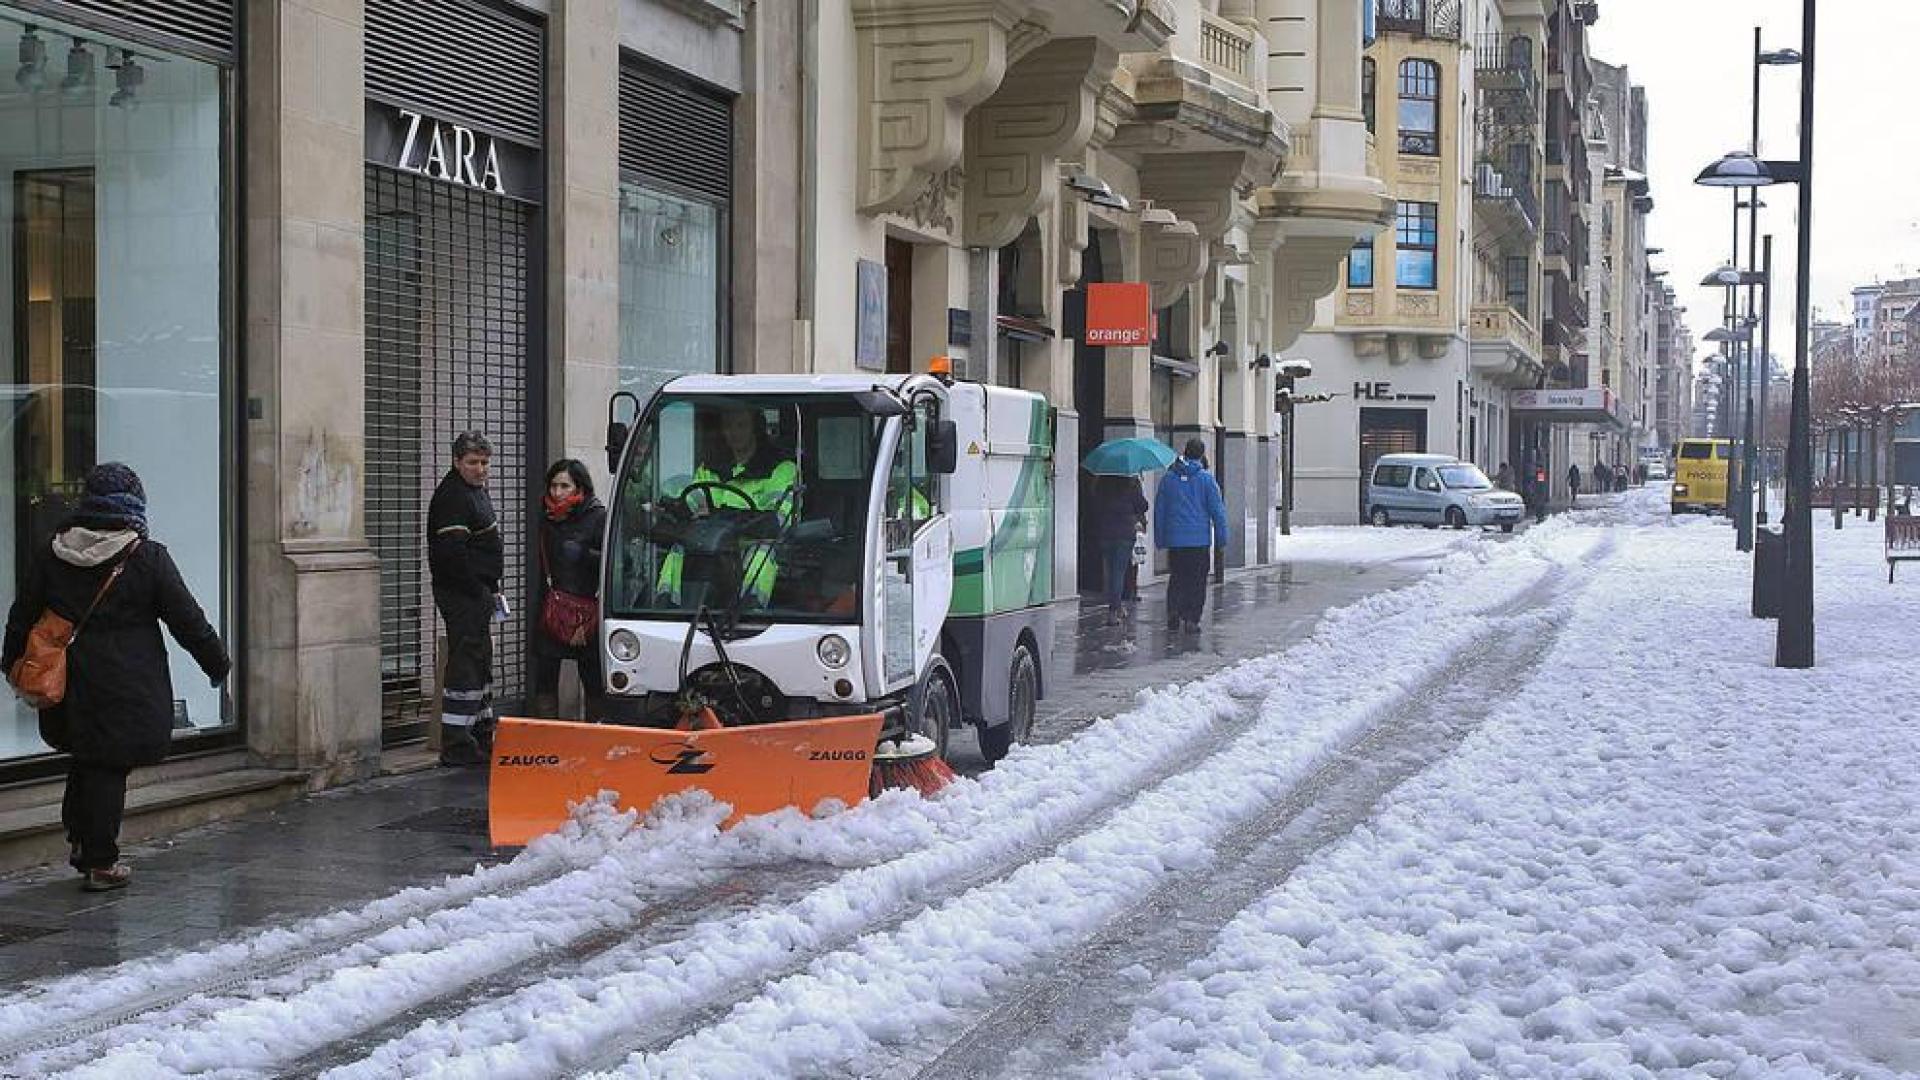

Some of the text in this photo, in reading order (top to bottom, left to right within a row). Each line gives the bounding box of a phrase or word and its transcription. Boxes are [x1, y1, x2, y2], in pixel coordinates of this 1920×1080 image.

[399, 109, 505, 195] ZARA
[1089, 329, 1140, 343] orange
[498, 755, 560, 767] ZAUGG
[808, 750, 867, 761] ZAUGG
